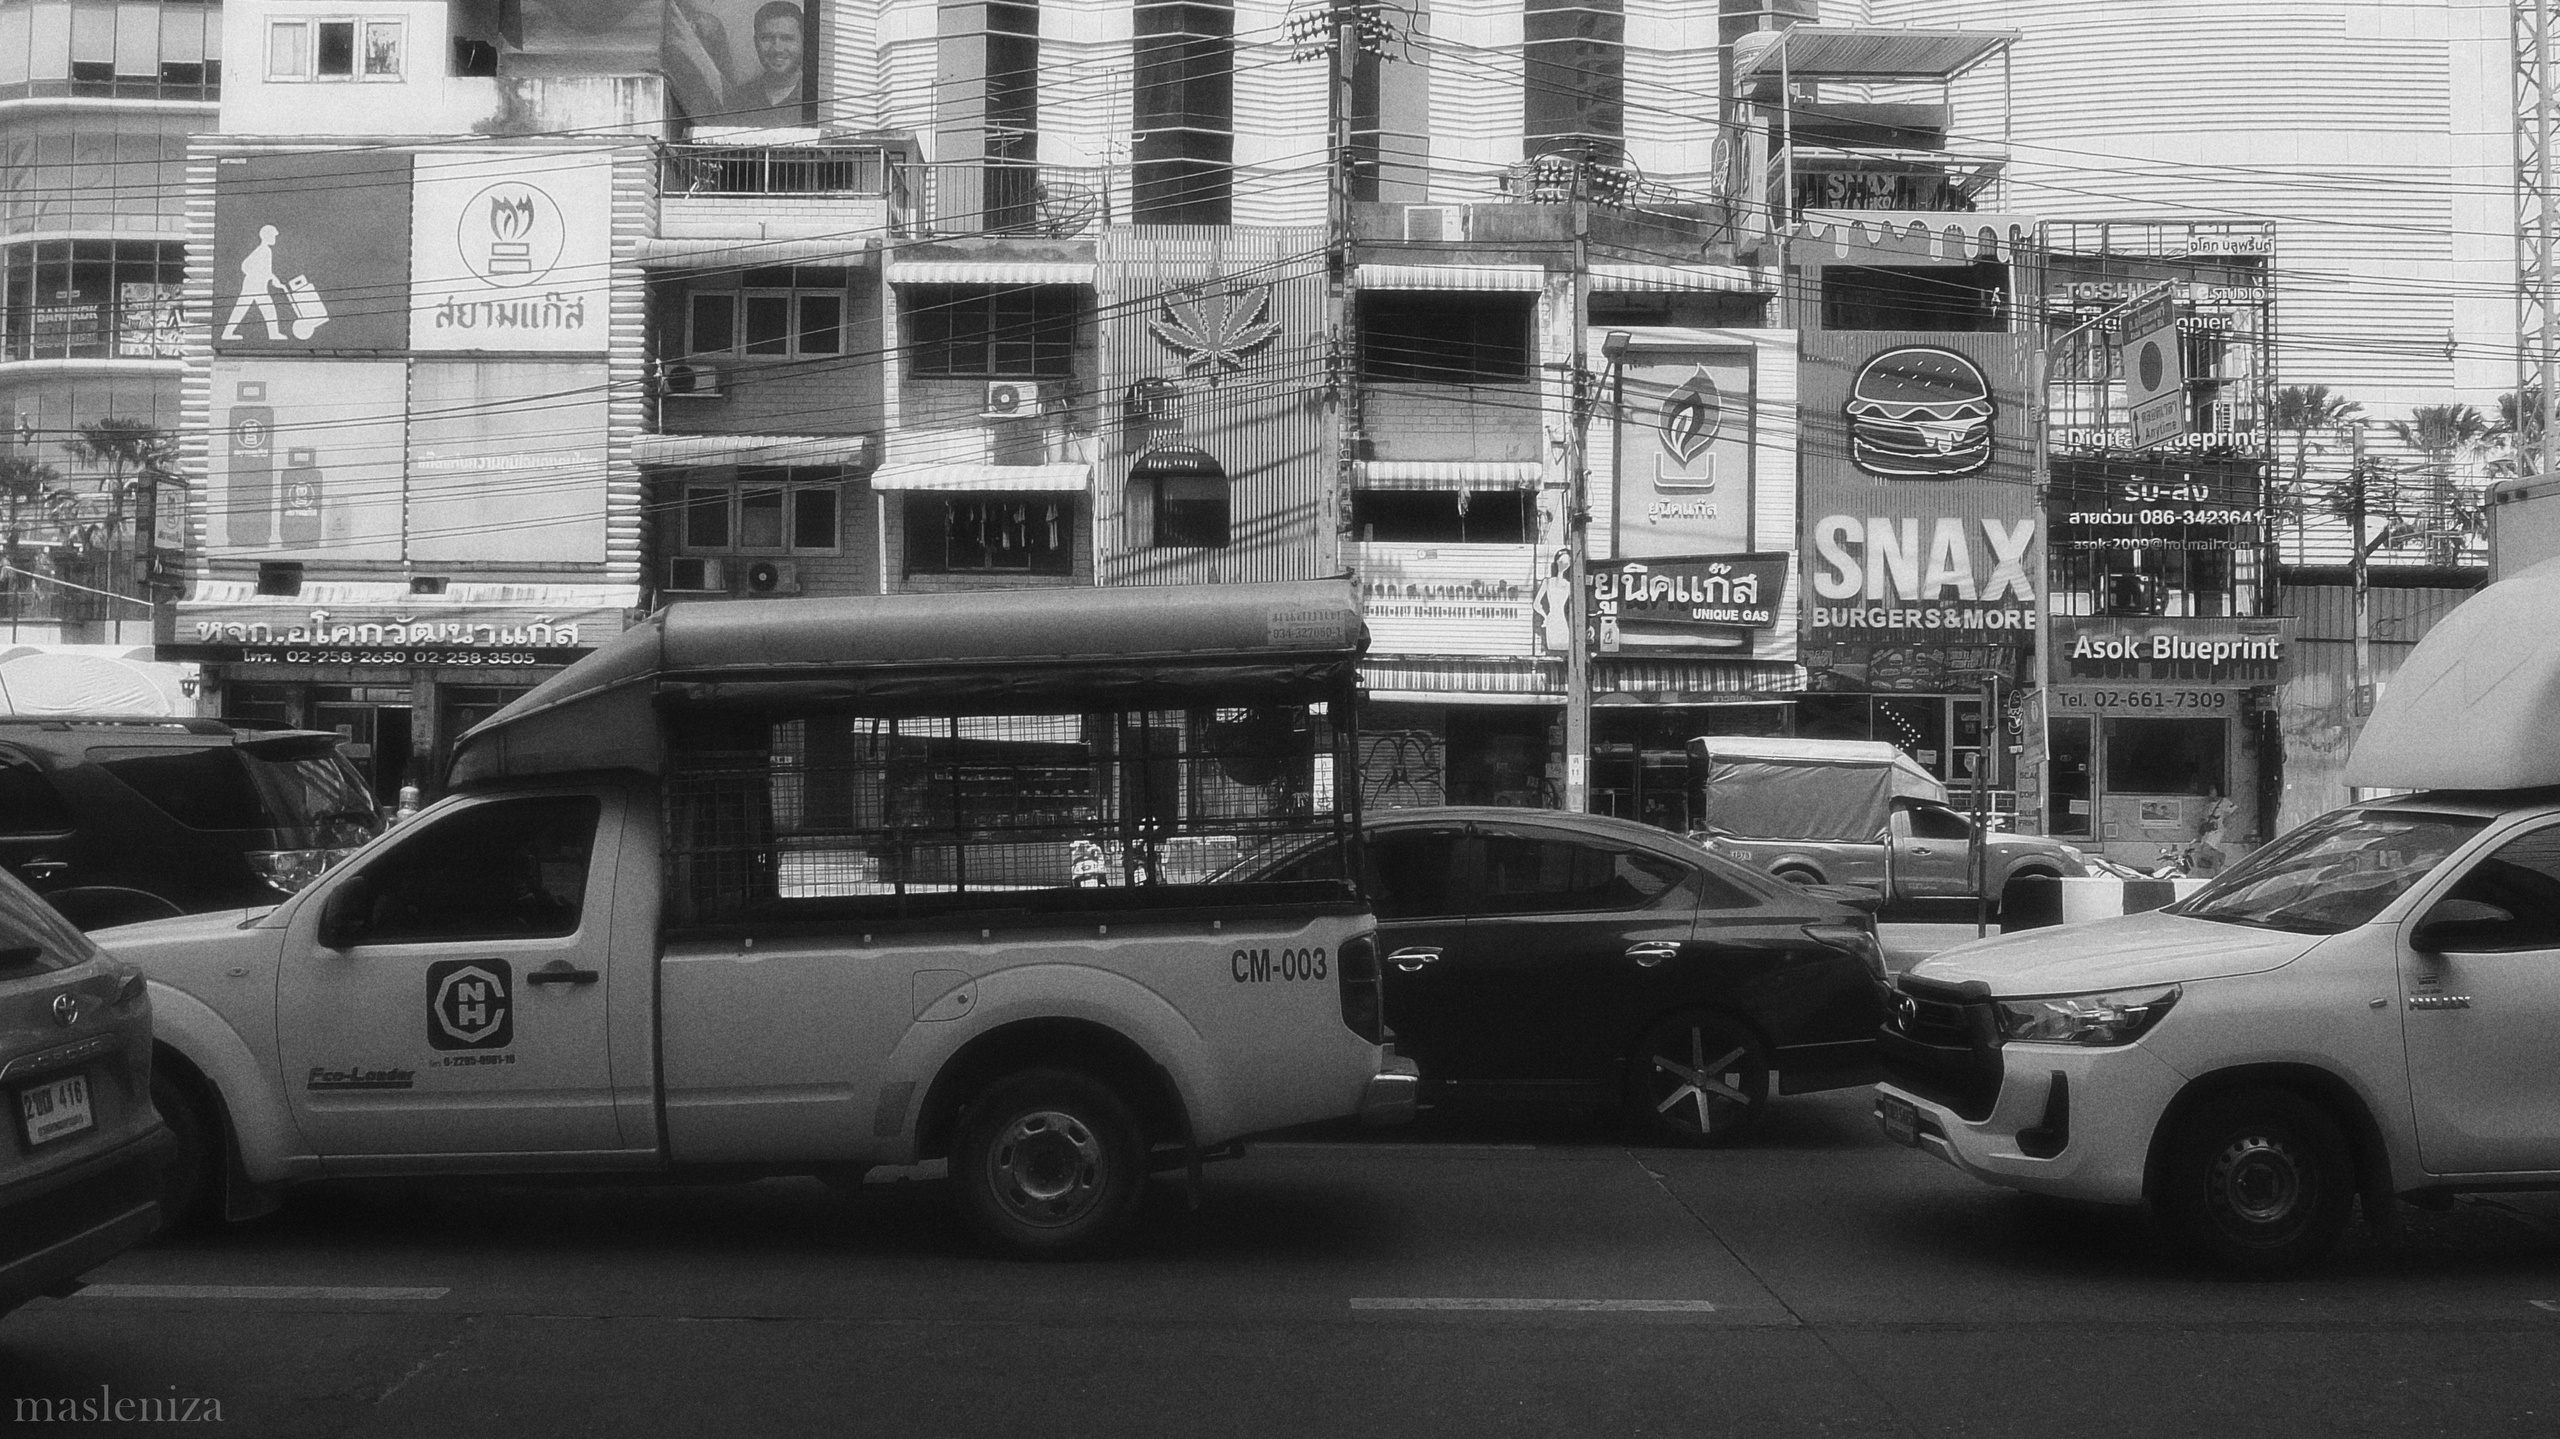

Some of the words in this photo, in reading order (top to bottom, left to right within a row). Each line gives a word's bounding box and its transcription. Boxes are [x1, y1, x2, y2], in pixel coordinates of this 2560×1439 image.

[2145, 421, 2177, 440] Anytime
[2069, 508, 2134, 525] สายด่วน
[1813, 514, 2036, 601] SNAX
[1594, 562, 1758, 615] ยูนิคแก๊ส
[1693, 607, 1739, 621] UNIQUE
[1742, 610, 1769, 622] GAS
[1812, 606, 2036, 630] BURGERS&MORE
[286, 650, 407, 663] 02-258-2650
[414, 651, 536, 664] 02-258-3505
[2073, 635, 2140, 660] Asok
[2152, 635, 2280, 666] Blueprint
[2059, 692, 2088, 708] Tel.
[2094, 691, 2226, 709] 02-661-7309
[1231, 946, 1328, 984] CM-003
